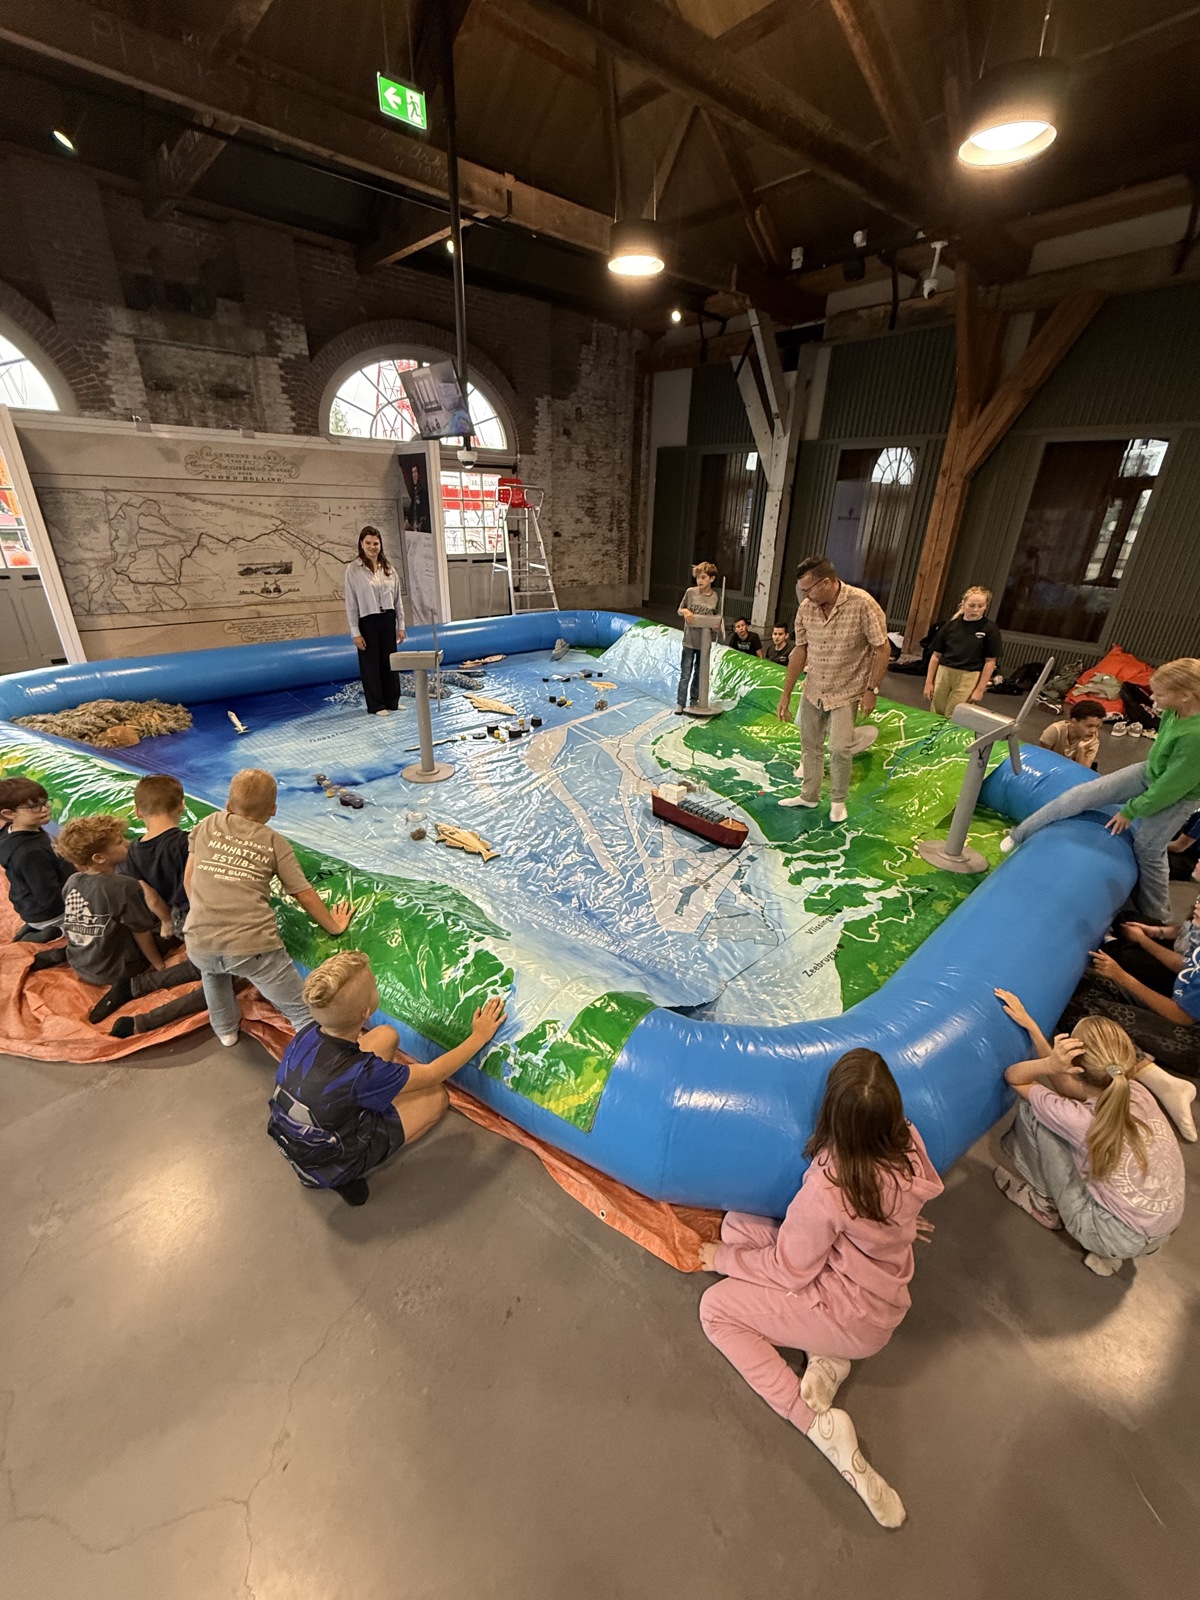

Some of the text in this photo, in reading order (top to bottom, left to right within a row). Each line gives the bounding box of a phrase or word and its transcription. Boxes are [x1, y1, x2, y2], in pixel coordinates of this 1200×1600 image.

[208, 840, 270, 864] MANHATTAN
[197, 864, 226, 874] DENIM
[802, 948, 840, 978] Zeebrugge
